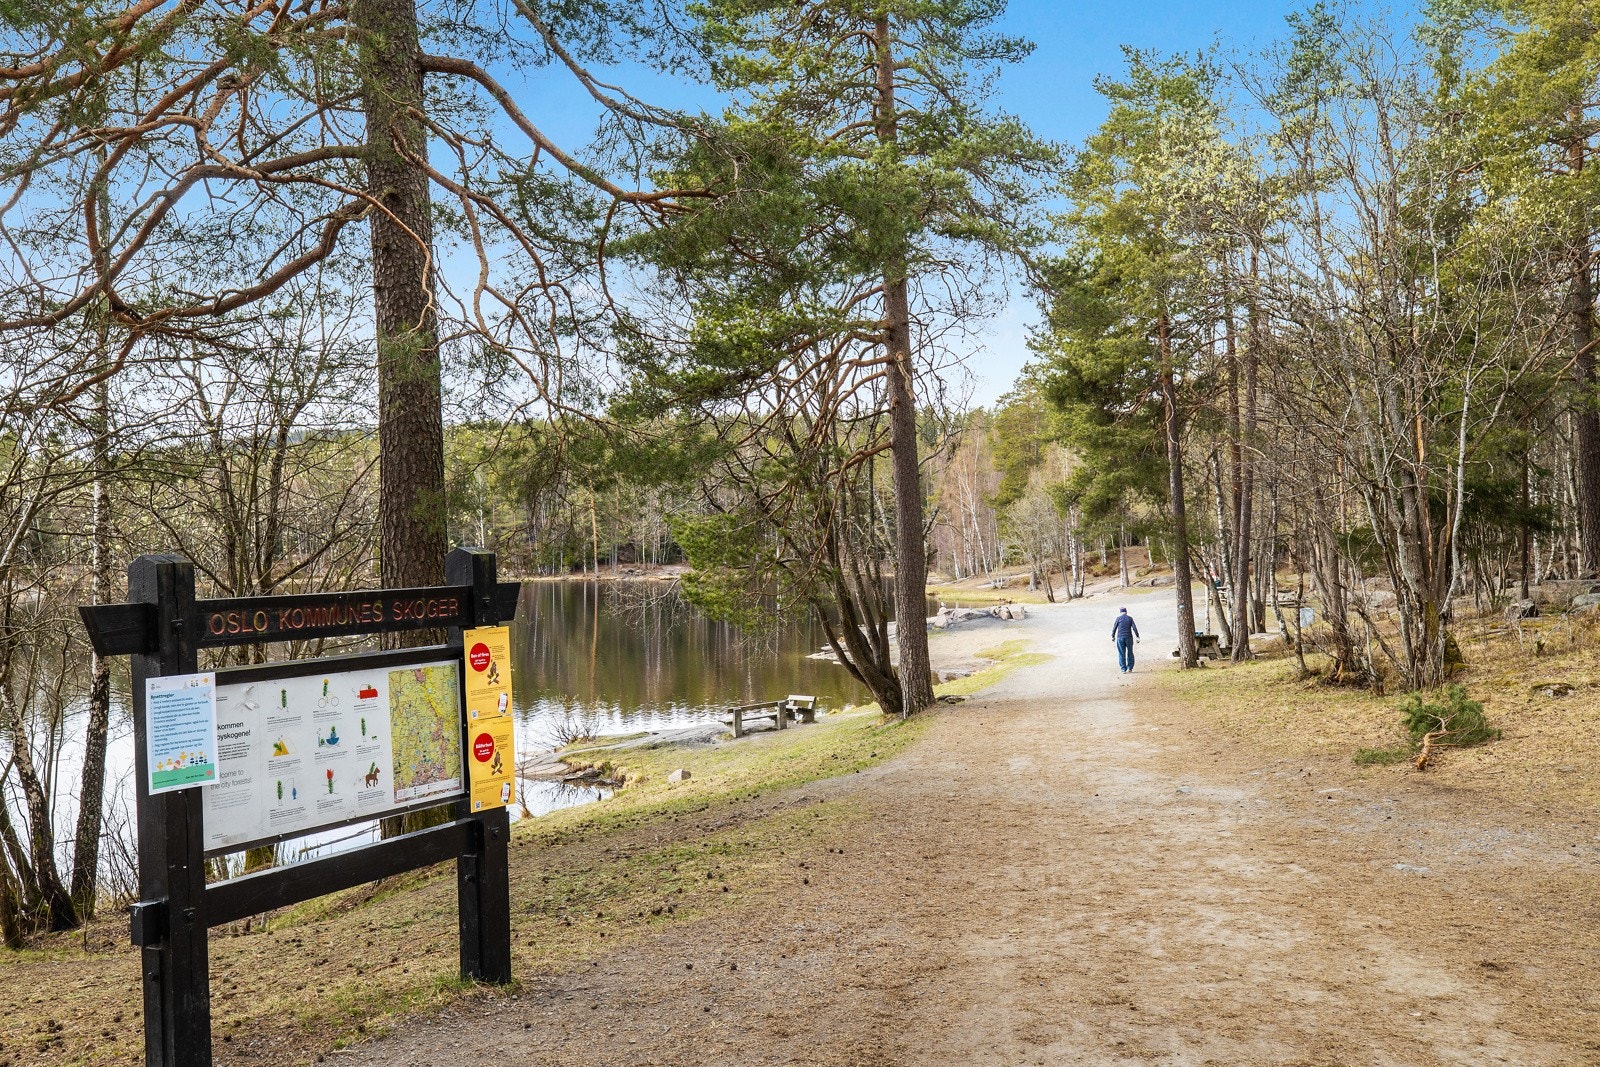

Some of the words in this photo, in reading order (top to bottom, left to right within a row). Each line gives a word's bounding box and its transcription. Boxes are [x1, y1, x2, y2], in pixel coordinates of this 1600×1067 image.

[209, 610, 268, 635] OSLO
[279, 601, 384, 630] KOMMUNES
[392, 599, 459, 620] SKOGER
[217, 721, 244, 731] kommen
[220, 781, 231, 789] city
